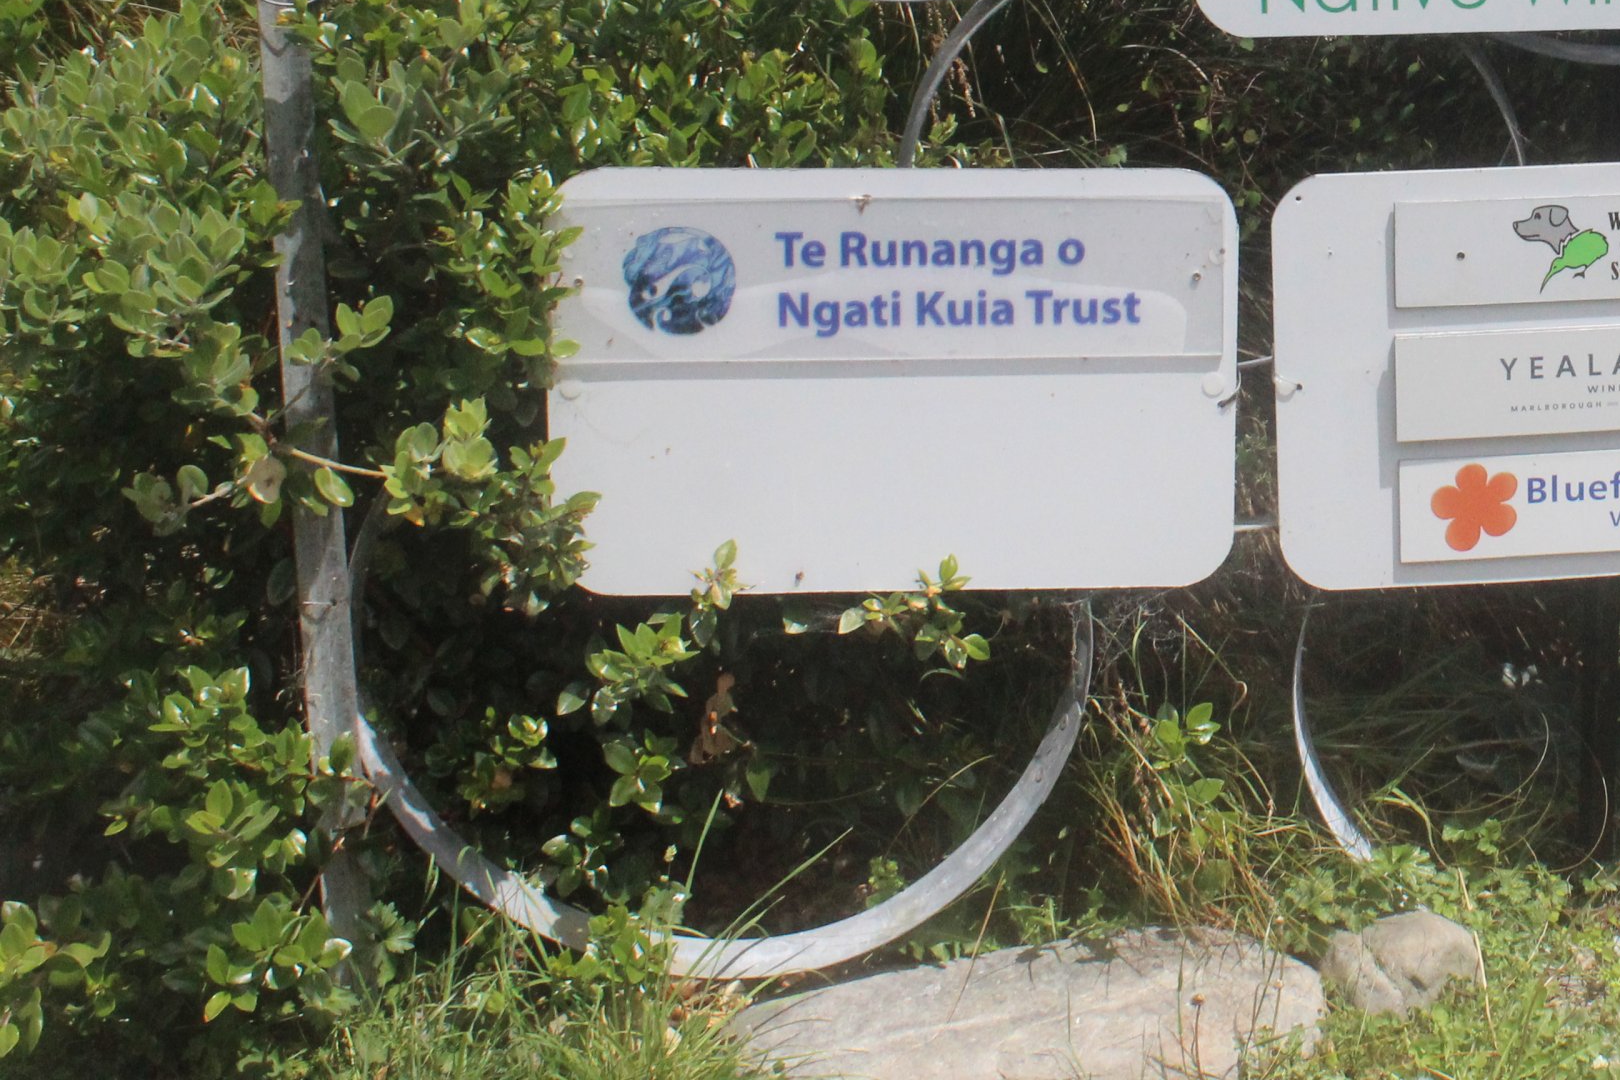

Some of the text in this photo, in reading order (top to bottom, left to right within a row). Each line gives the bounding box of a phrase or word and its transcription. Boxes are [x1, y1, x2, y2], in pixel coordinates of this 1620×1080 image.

[775, 230, 1086, 277] Te Runanga o
[777, 288, 1142, 338] Ngati Kuia Trust
[1510, 400, 1603, 413] MARLBOROUGH
